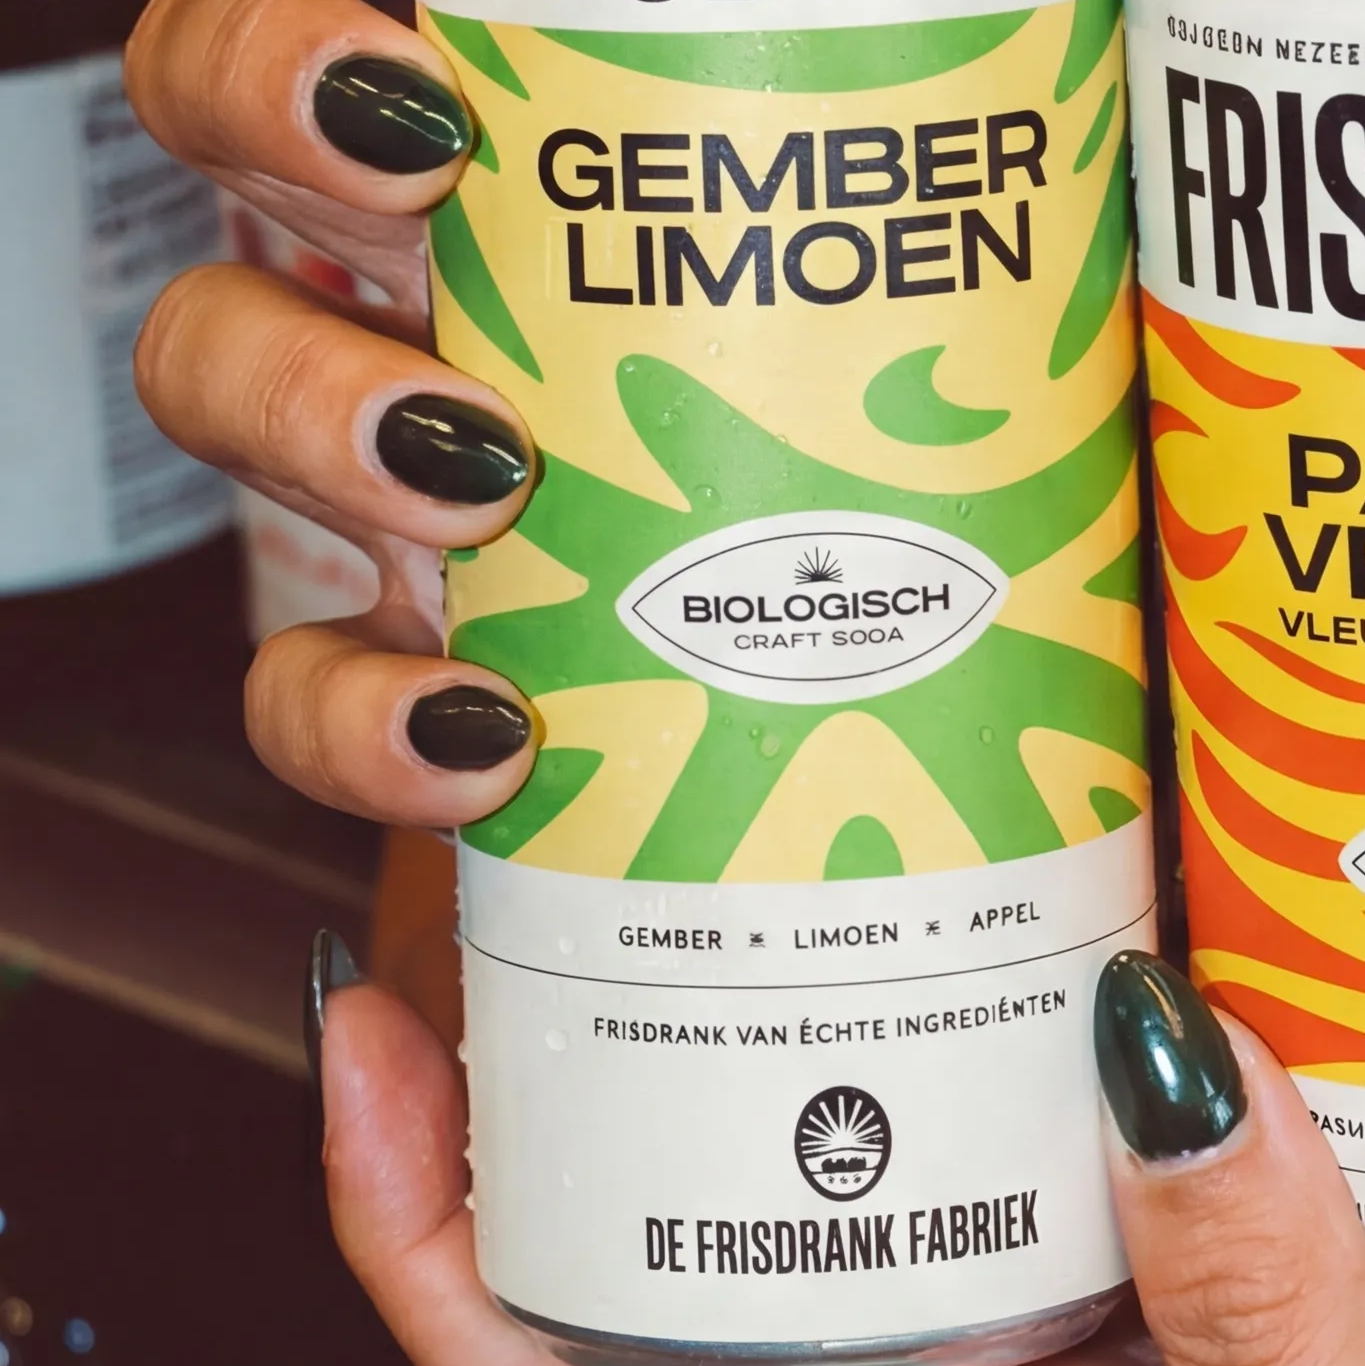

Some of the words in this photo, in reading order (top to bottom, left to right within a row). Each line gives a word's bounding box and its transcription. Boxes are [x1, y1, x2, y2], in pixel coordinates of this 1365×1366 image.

[538, 109, 1048, 214] GEMBER
[566, 199, 1032, 307] LIMOEN
[682, 583, 951, 625] BIOLOGISCH
[733, 631, 822, 651] CRAFT
[618, 925, 724, 952] GEMBER
[793, 922, 900, 951] LIMOEN
[968, 900, 1042, 934] APPEL
[593, 1016, 729, 1047] FRISDRANK
[735, 1024, 789, 1047] VAN
[799, 1016, 887, 1046] ÉCHTE
[645, 1215, 686, 1273] DE
[696, 1213, 898, 1276] FRISDRANK
[908, 1188, 1040, 1266] FABRIEK
